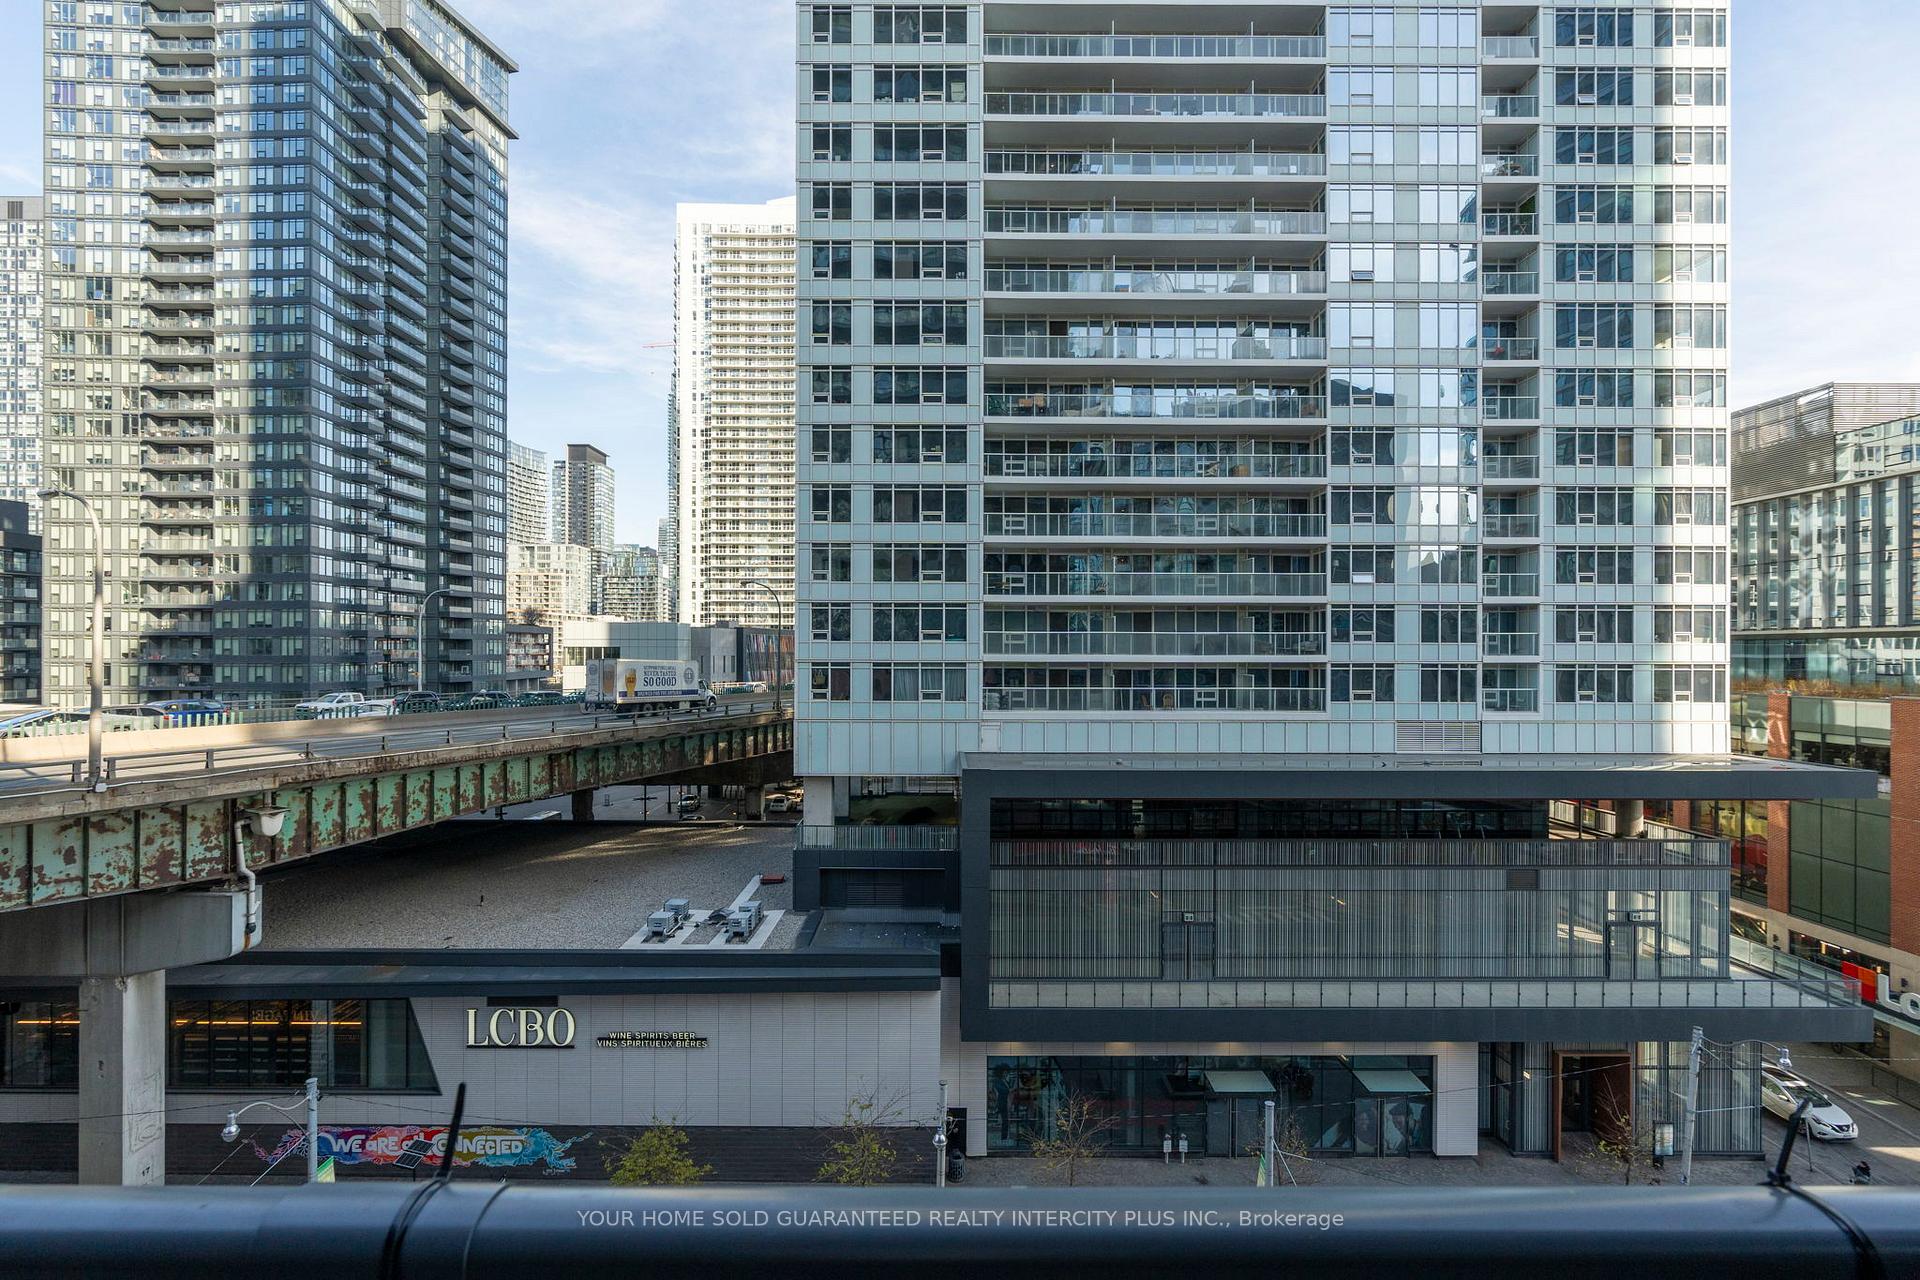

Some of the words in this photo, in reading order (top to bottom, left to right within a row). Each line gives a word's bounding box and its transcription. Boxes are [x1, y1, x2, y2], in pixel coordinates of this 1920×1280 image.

[644, 677, 654, 687] SO
[655, 677, 677, 687] GOOD
[466, 1008, 576, 1047] LCBO
[608, 1031, 632, 1040] WINE
[635, 1031, 669, 1040] SPIRITS
[672, 1031, 696, 1040] BEER
[597, 1040, 618, 1048] VINS
[620, 1040, 673, 1048] SPIRITUEUX
[675, 1039, 708, 1048] BIÈRES
[325, 1133, 366, 1153] WE
